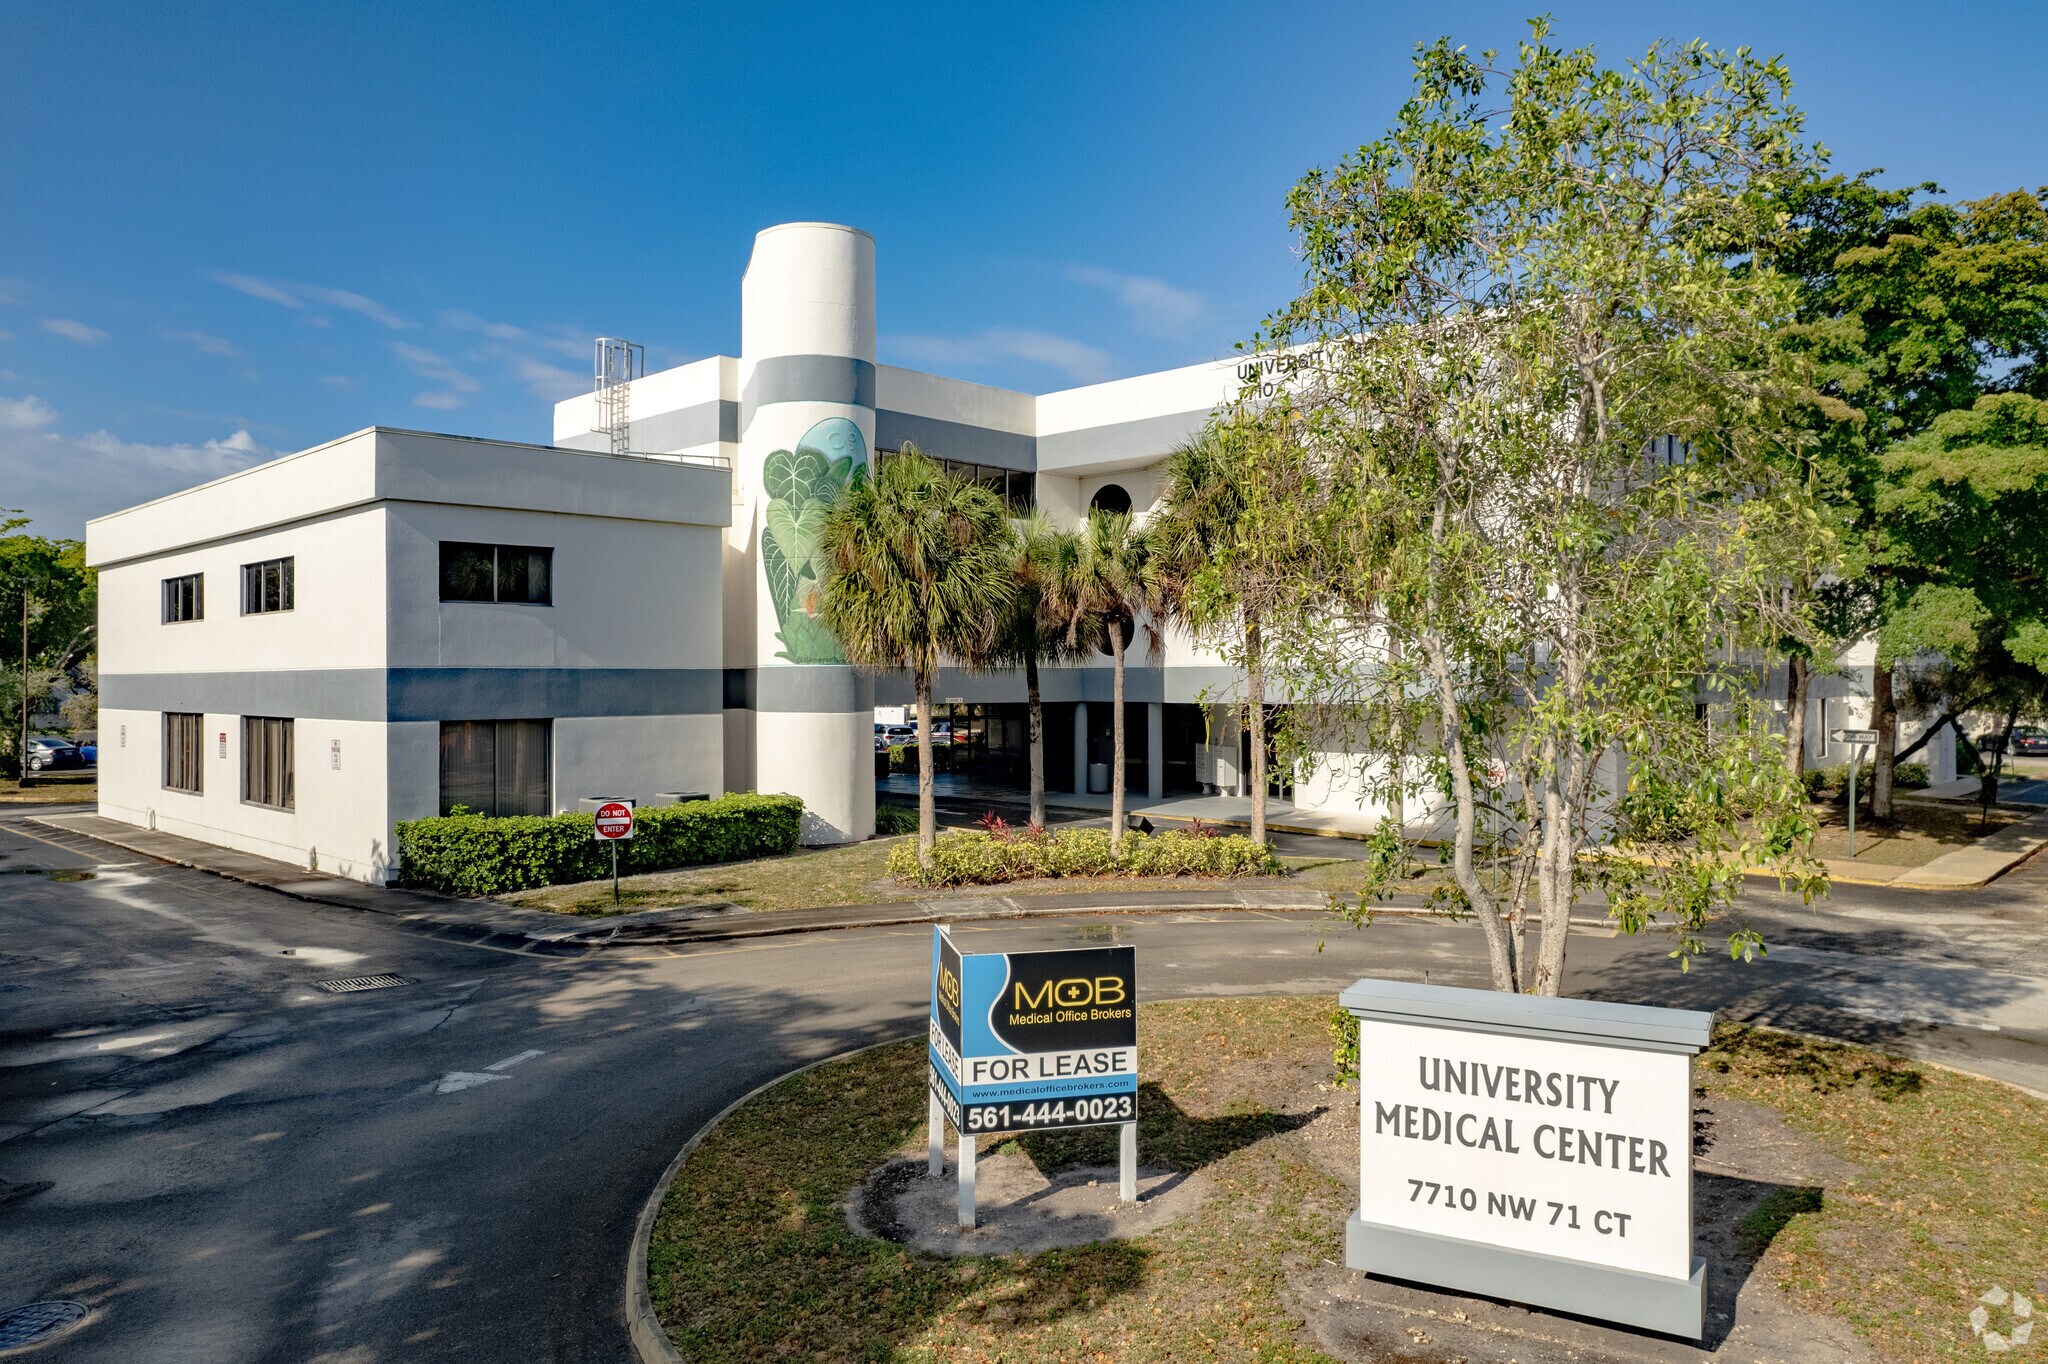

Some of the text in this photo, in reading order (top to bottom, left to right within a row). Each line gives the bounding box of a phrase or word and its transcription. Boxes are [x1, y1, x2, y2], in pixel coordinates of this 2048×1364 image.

[1014, 976, 1126, 1010] MOB
[1009, 1007, 1132, 1026] Medical Office Brokers
[972, 1057, 1030, 1082] FOR
[1039, 1051, 1128, 1078] LEASE
[972, 1079, 1129, 1098] www.medicalofficebrokers.com
[1419, 1056, 1620, 1114] UNIVERSITY
[968, 1096, 1132, 1130] 561-444-0023
[1375, 1101, 1671, 1177] MEDICAL CENTER
[1407, 1179, 1632, 1238] 7710 NW 71 CT
